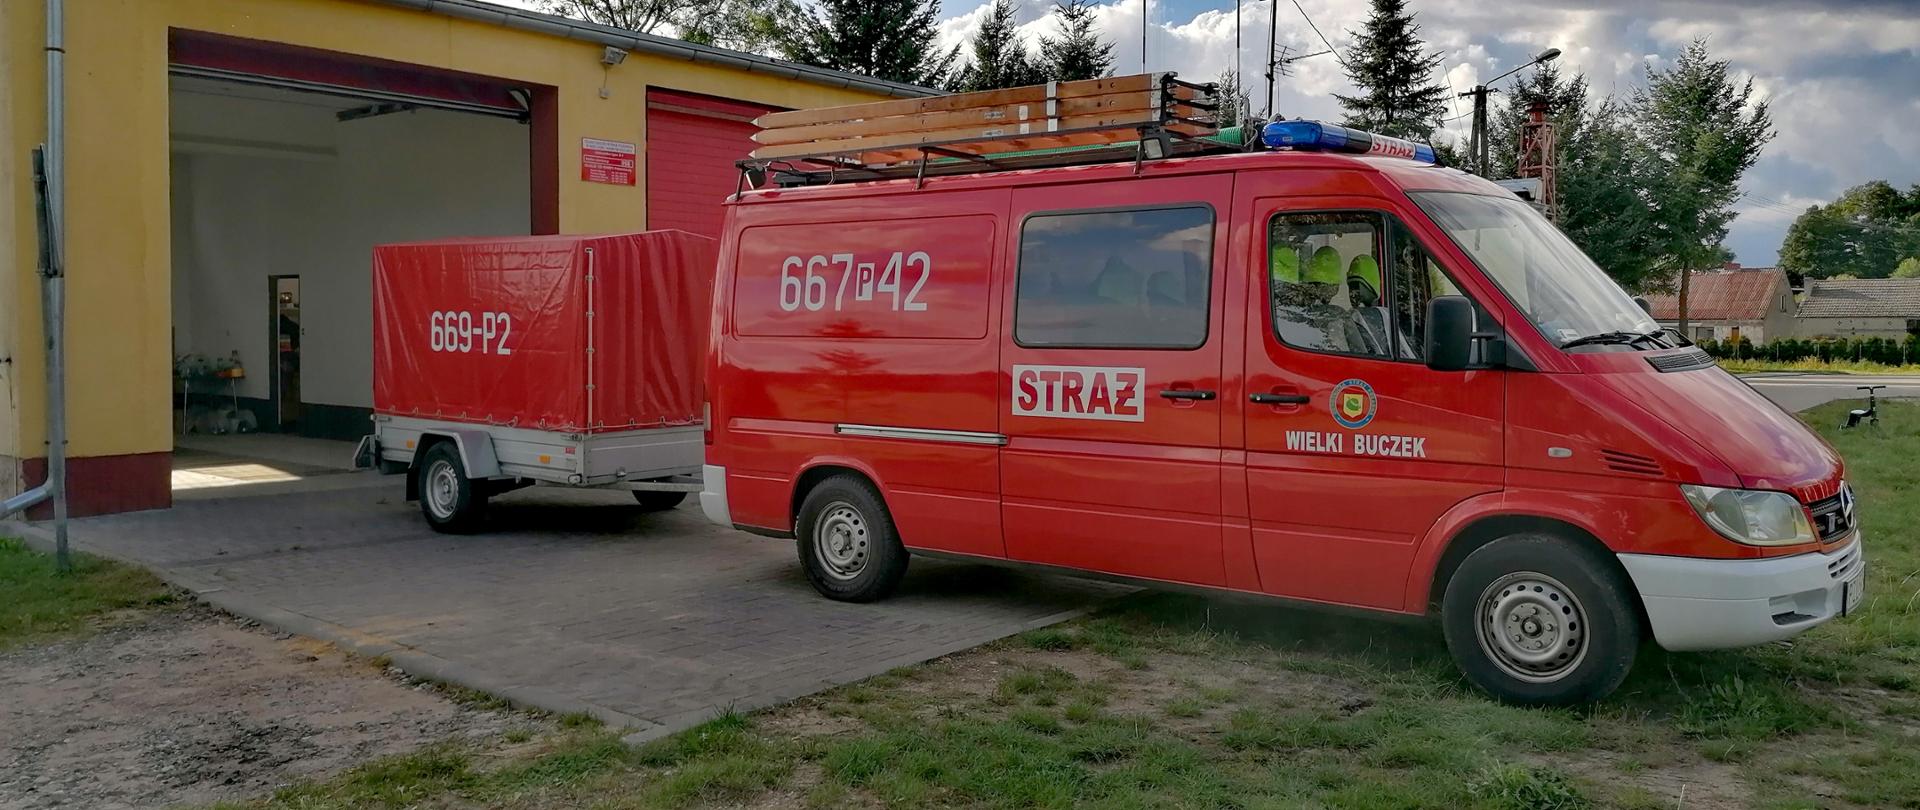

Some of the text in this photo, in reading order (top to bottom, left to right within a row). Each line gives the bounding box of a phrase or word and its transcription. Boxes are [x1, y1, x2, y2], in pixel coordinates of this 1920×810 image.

[431, 310, 511, 355] 669-P2
[1285, 430, 1426, 458] WIELKI BUCZEK
